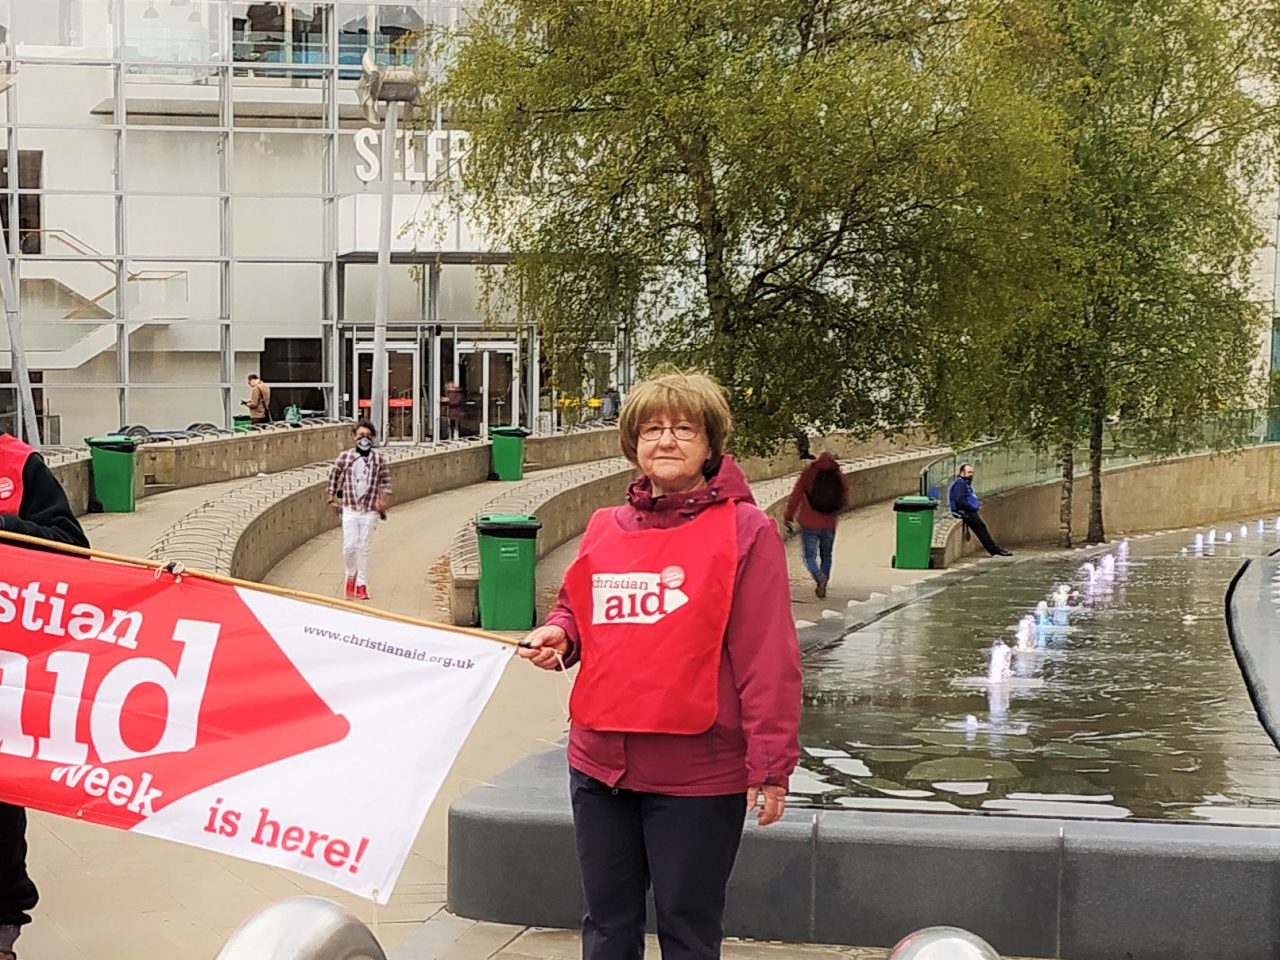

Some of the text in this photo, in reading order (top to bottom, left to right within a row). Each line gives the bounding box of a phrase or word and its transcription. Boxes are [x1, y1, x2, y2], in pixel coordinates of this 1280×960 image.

[592, 577, 649, 591] christian
[605, 582, 668, 621] aid
[303, 625, 476, 671] www.christianaid.org.uk
[50, 763, 165, 818] week
[203, 797, 370, 874] is here!
